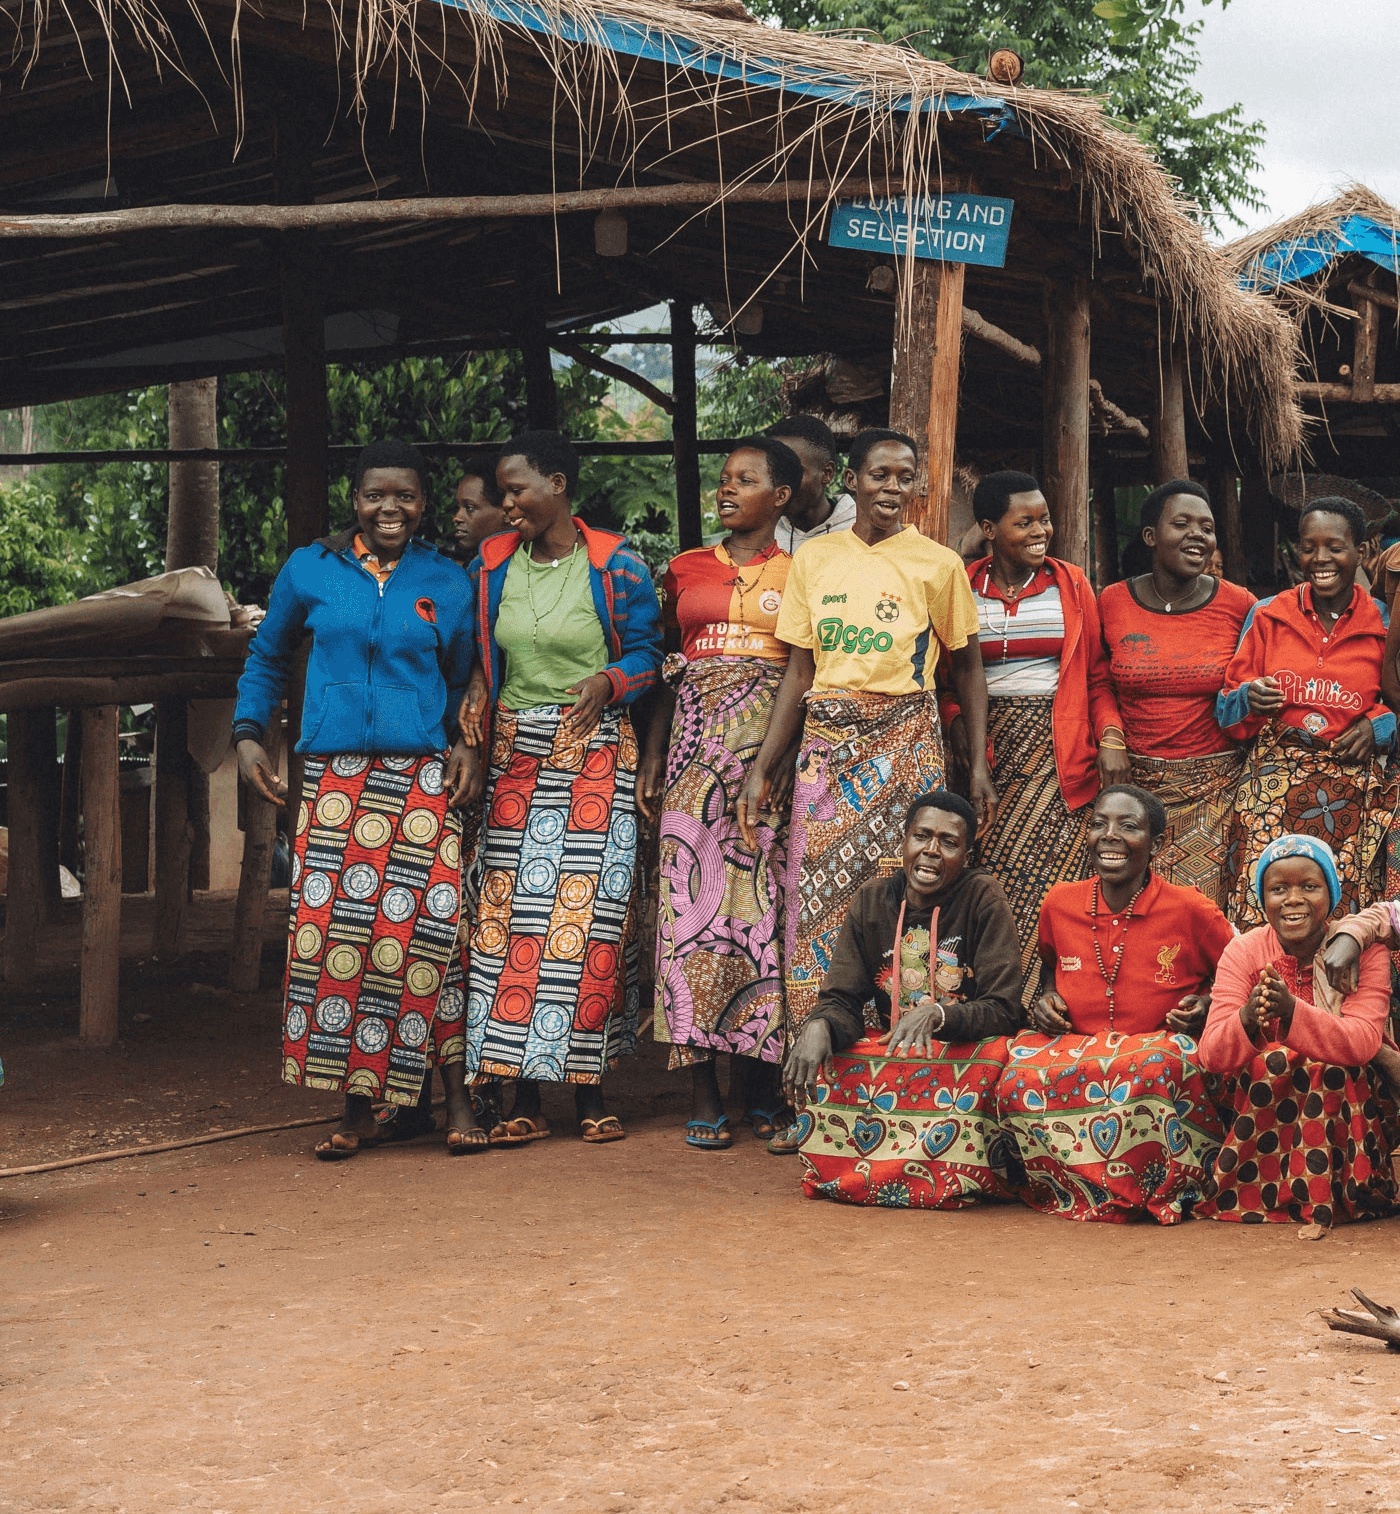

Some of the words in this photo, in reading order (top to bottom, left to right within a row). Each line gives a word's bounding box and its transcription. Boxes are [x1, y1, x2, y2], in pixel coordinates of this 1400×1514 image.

[956, 203, 1005, 226] AND
[847, 218, 985, 253] SELECTION
[695, 637, 764, 651] TELEKOM
[1272, 669, 1363, 711] Phillies
